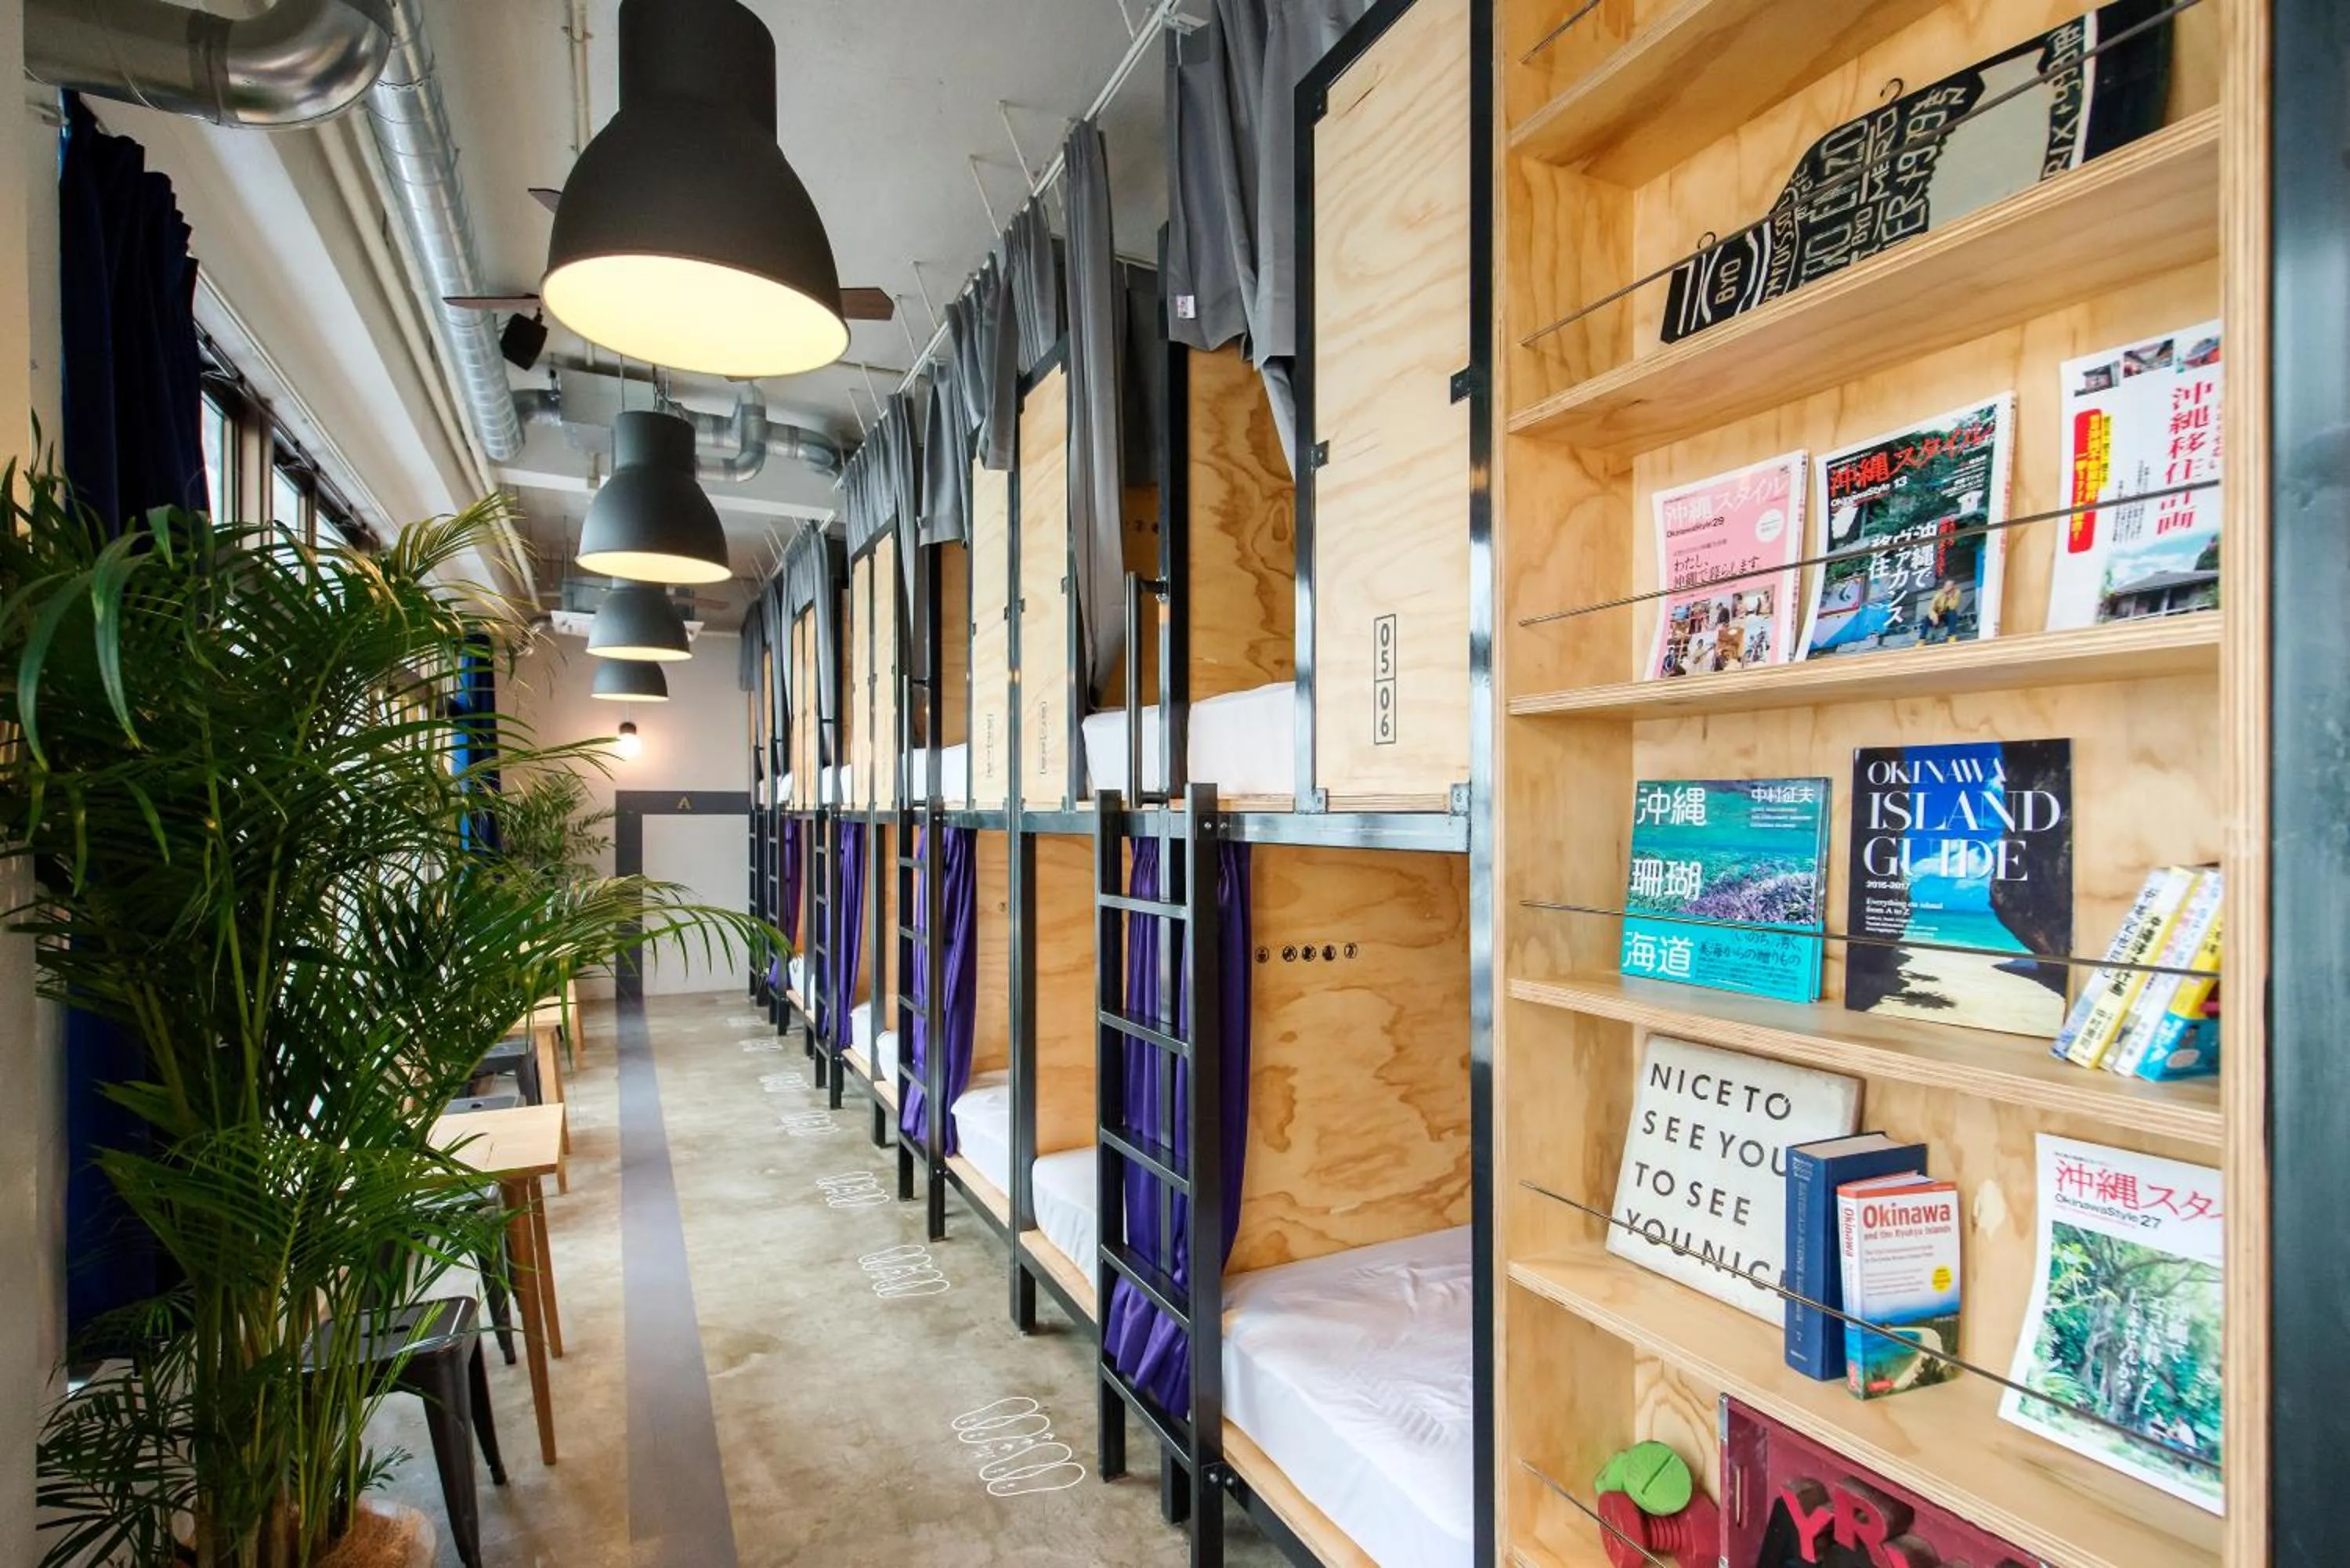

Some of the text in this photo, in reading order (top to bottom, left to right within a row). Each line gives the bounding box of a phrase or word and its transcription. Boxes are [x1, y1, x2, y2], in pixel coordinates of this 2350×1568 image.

[1715, 258, 1741, 305] BYO
[1893, 475, 1907, 490] 13
[1867, 758, 2007, 785] OKINAWA
[1637, 786, 1708, 826] 沖縄
[1867, 790, 2061, 833] ISLAND
[1630, 858, 1703, 901] 珊瑚
[1864, 836, 2028, 882] GUIDE
[1623, 931, 1694, 978] 海道
[1650, 1063, 1792, 1121] NICE TO
[1642, 1110, 1706, 1151] SEE
[1719, 1130, 1787, 1177] YOU
[1635, 1162, 1752, 1227] TO SEE
[2055, 1158, 2225, 1222] 沖縄スタ
[2055, 1193, 2139, 1223] OkinawaStyle
[2139, 1215, 2162, 1229] 27
[1625, 1208, 1692, 1255] YOU
[1843, 1207, 1855, 1258] Okinawa
[1863, 1202, 1951, 1229] Okinawa
